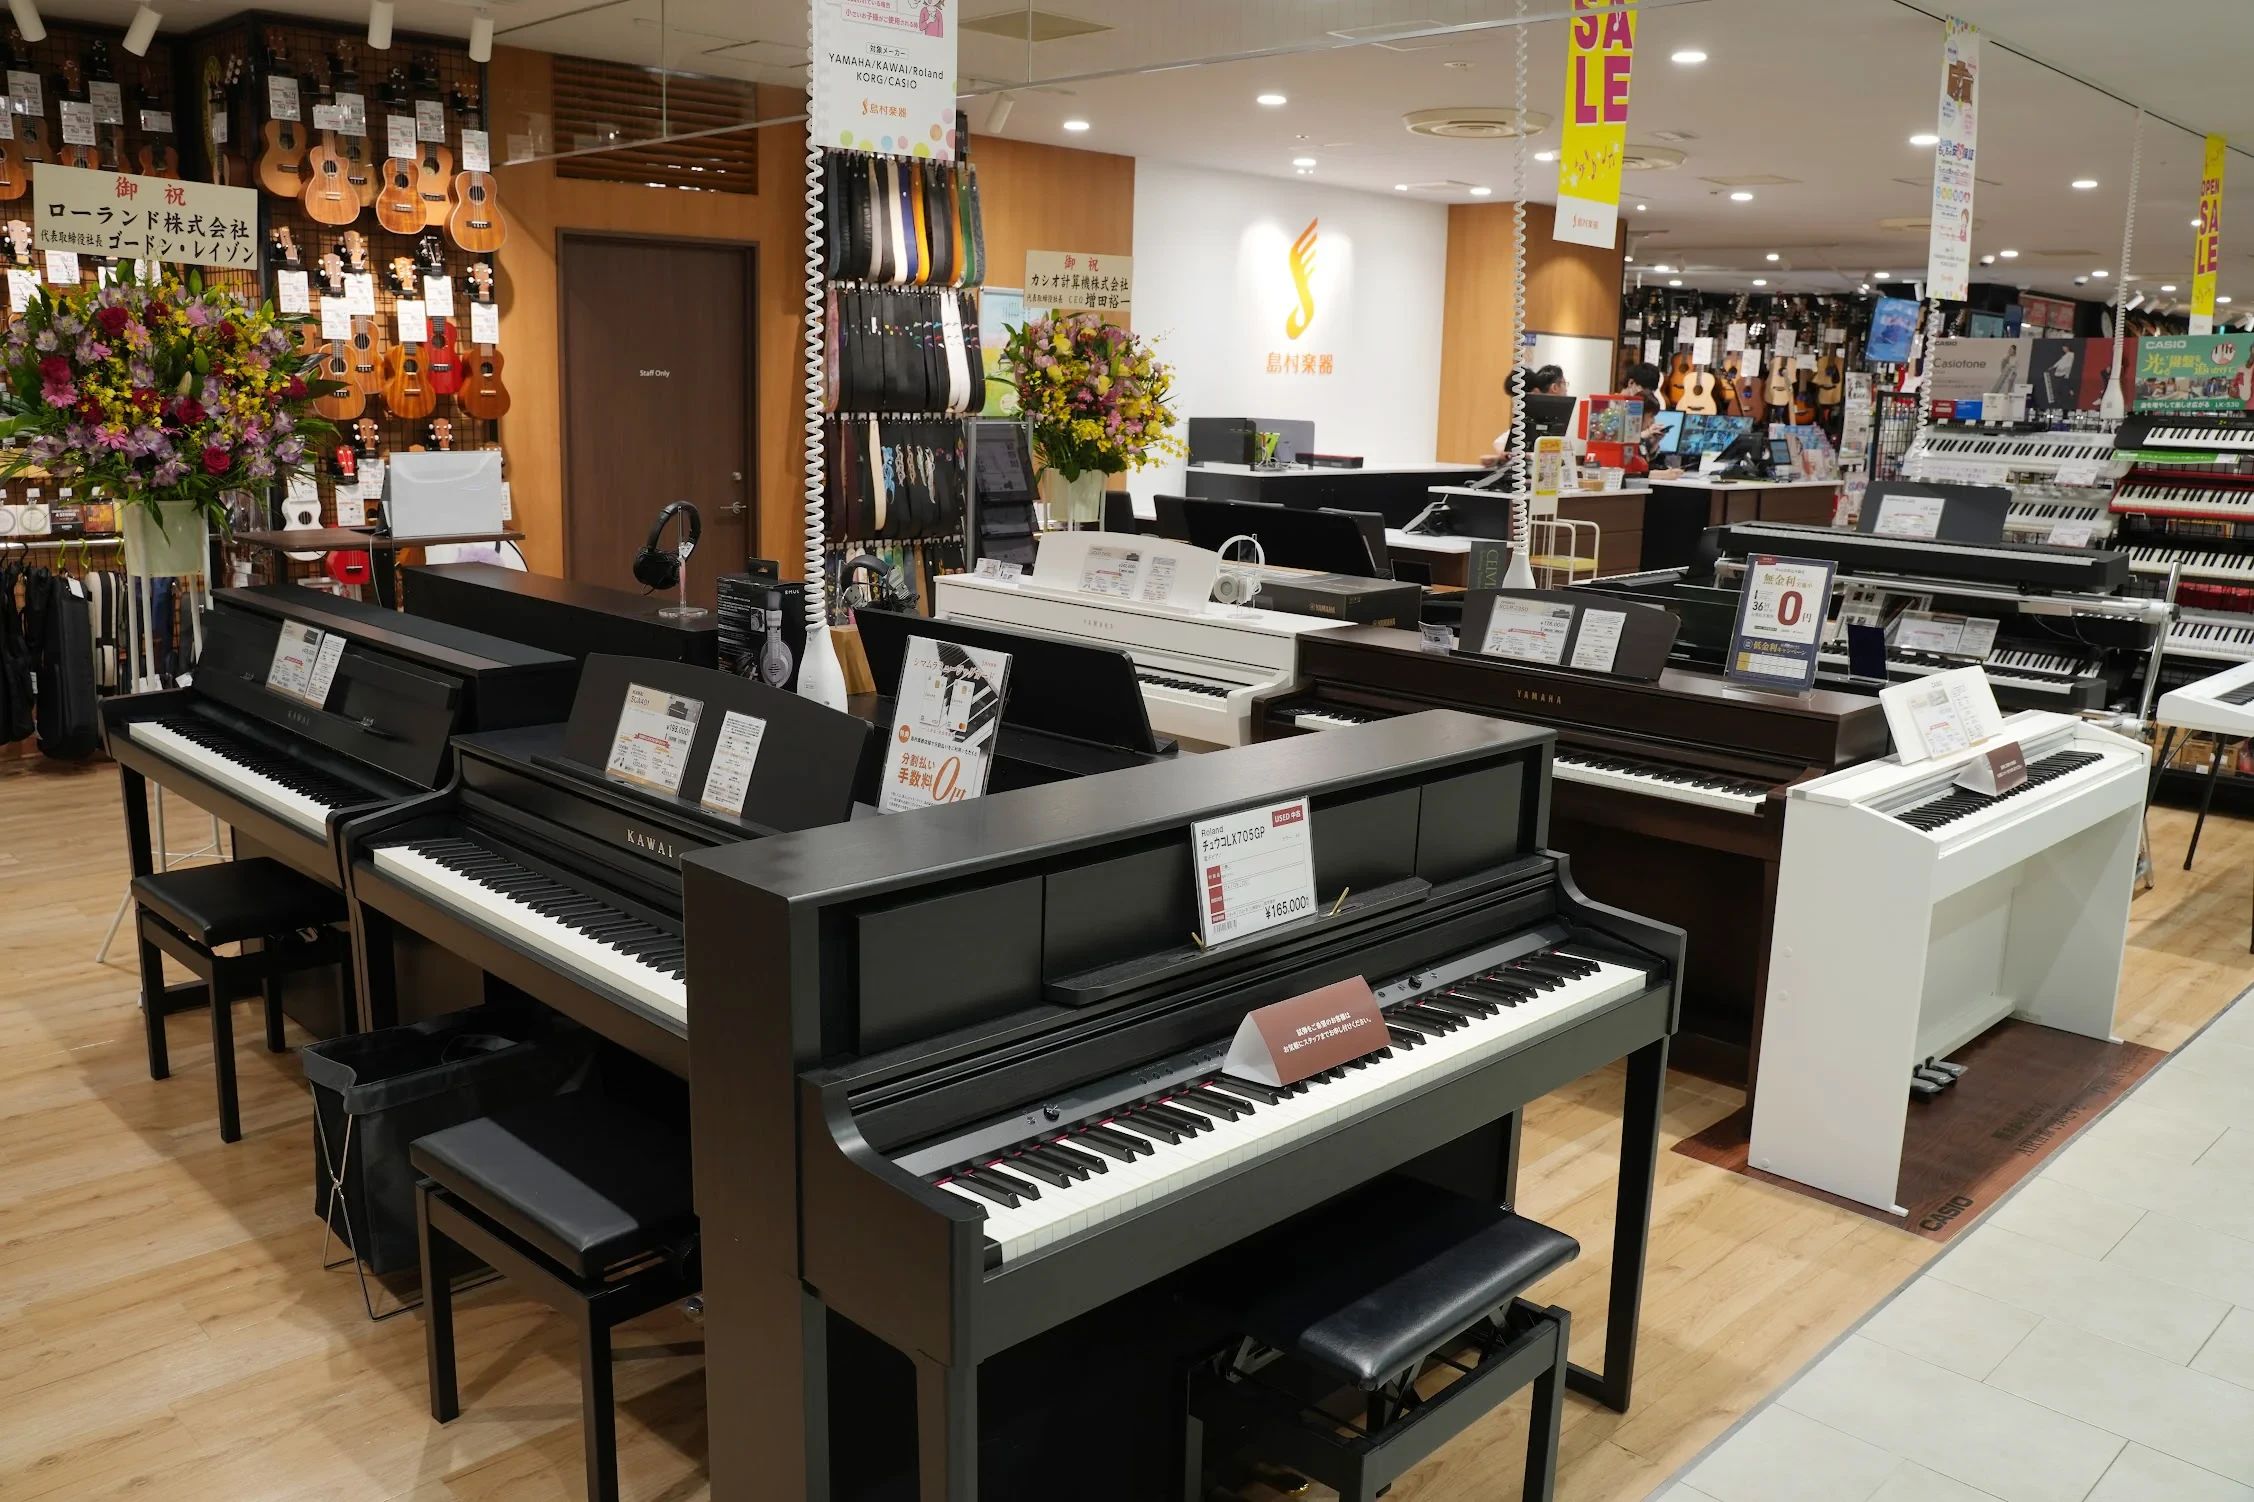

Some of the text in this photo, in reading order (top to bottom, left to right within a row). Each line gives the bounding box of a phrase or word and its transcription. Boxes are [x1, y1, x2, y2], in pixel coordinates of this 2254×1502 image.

[869, 44, 907, 57] 対象メーカー
[828, 52, 944, 80] YAMAHA/KAWAI/Roland
[856, 72, 918, 90] KORG/CASIO
[870, 103, 907, 118] 島村楽器
[49, 204, 250, 240] ローランド株式会社
[108, 231, 255, 264] ゴードン・レイゾン
[1031, 274, 1129, 292] カシオ計算機株式会社
[2145, 340, 2187, 350] CASIO
[1266, 352, 1334, 375] 島村楽器
[1932, 358, 1987, 370] Casiotone
[640, 369, 670, 379] Staff Only
[1517, 689, 1561, 705] YAMAHA
[901, 751, 936, 770] 分割払い
[1274, 810, 1301, 823] USED 中古
[1201, 824, 1224, 838] Roland
[1203, 825, 1266, 852] チュウコLX705GP
[627, 829, 673, 858] KAWAI
[1265, 895, 1306, 920] ¥165,000
[1919, 1195, 1975, 1233] CASIO
